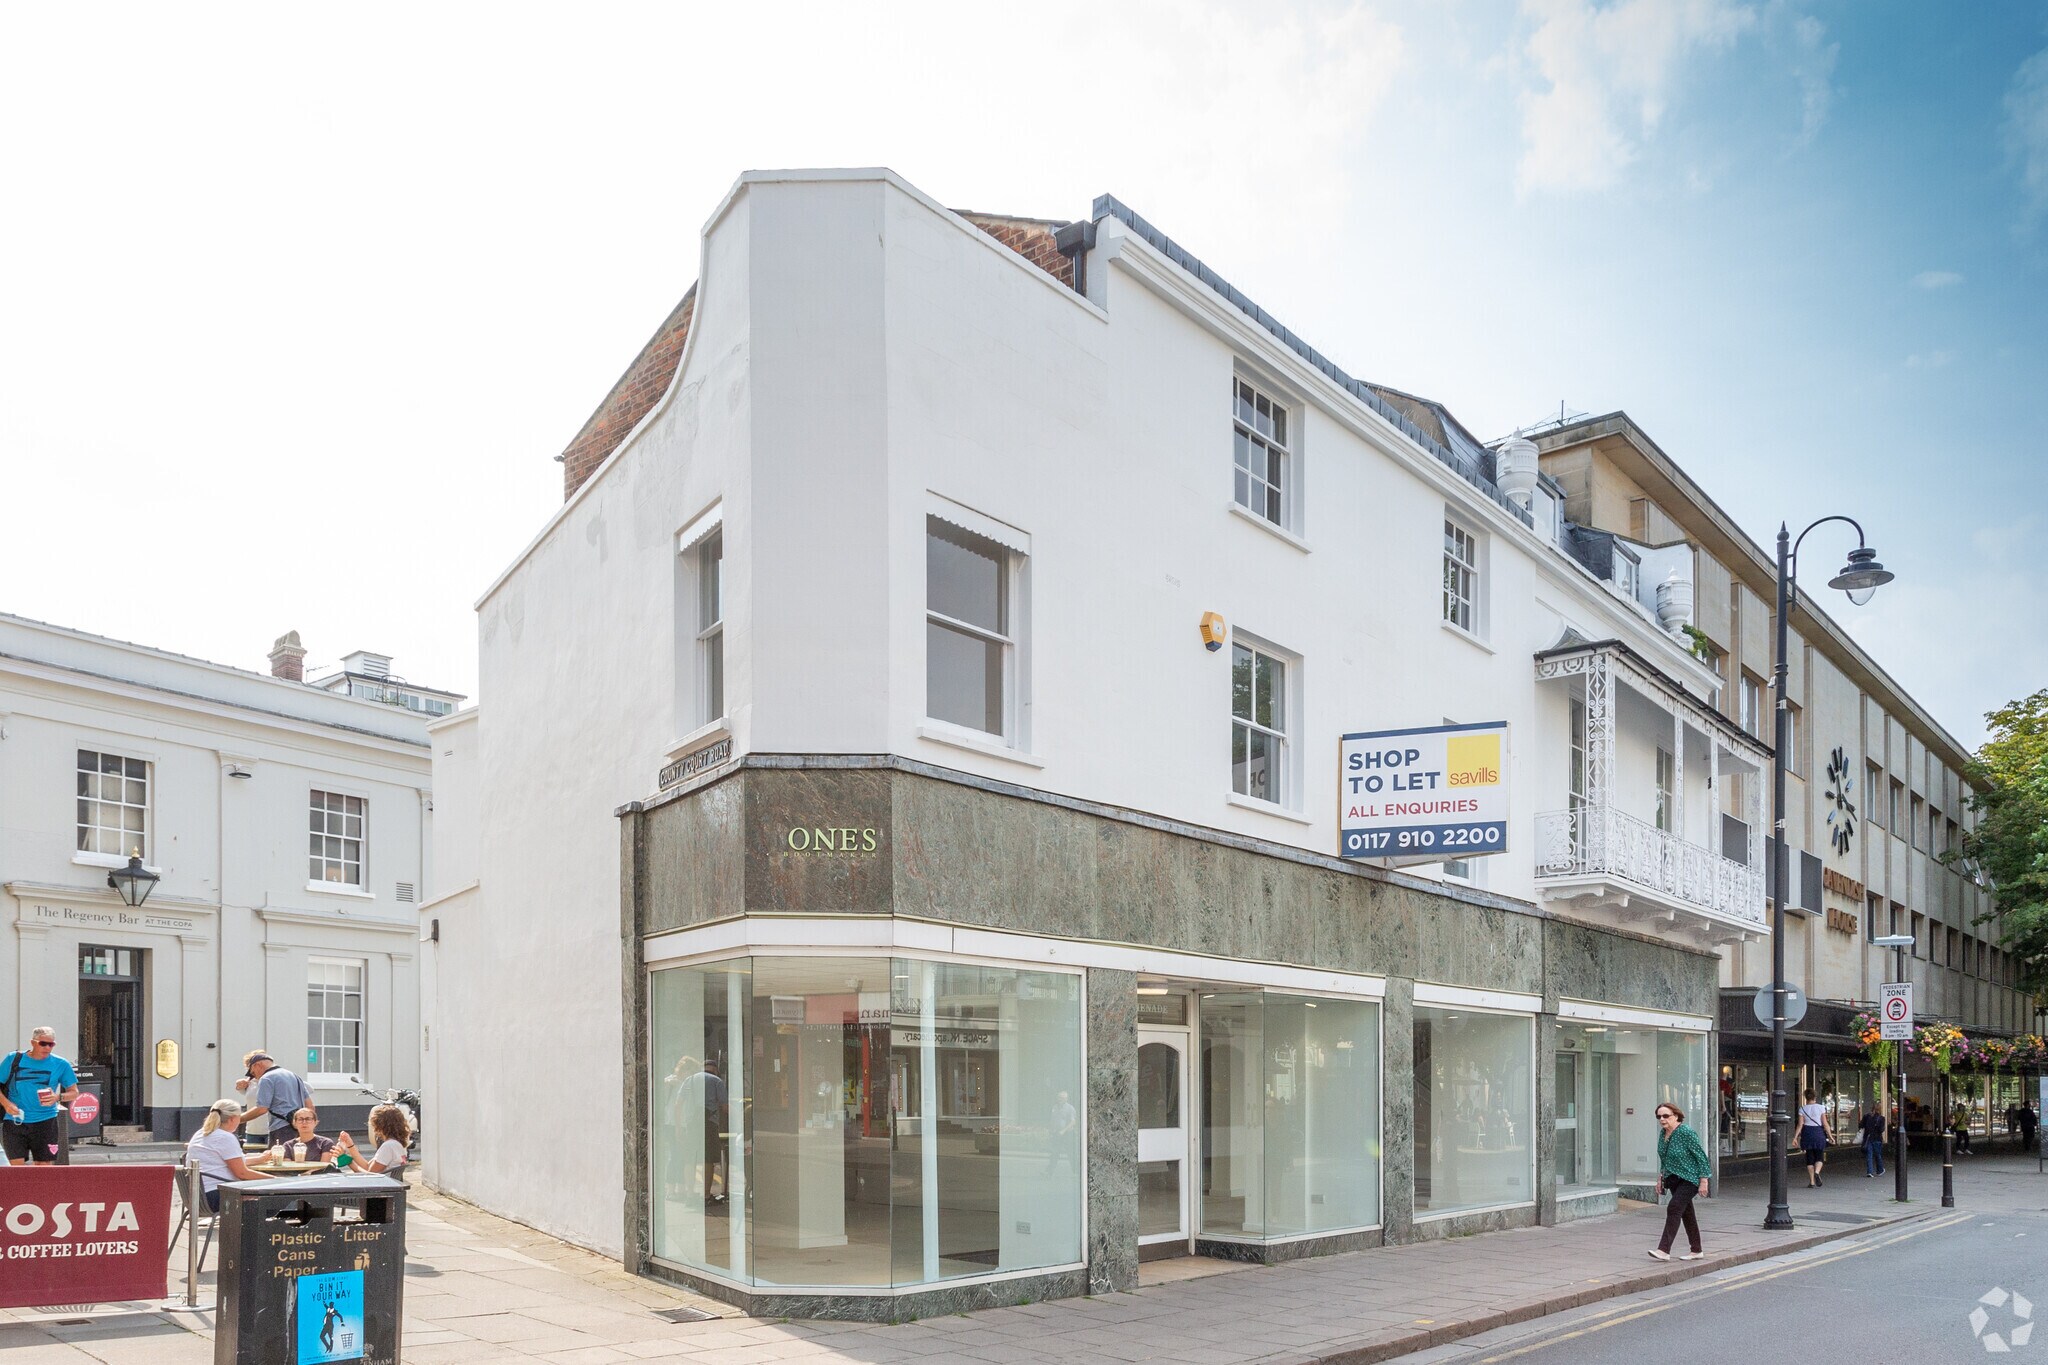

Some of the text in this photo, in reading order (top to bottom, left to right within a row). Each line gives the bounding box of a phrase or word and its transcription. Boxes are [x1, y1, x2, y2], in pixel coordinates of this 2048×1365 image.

[660, 742, 730, 785] COUNTY COURT ROAD
[1349, 749, 1420, 770] SHOP
[1349, 771, 1441, 794] TO LET
[1450, 767, 1498, 785] savills
[1348, 800, 1478, 818] ALL ENQUIRIES
[788, 827, 877, 852] ONES
[1348, 826, 1500, 850] 0117 910 2200
[34, 905, 59, 917] The
[63, 907, 115, 925] Regency
[118, 912, 140, 925] Bar
[157, 919, 171, 927] THE
[0, 1202, 140, 1238] OSTA
[271, 1233, 323, 1246] Plastic
[344, 1230, 381, 1242] Litter
[7, 1244, 72, 1259] COFFEE
[75, 1241, 139, 1257] LOVERS
[277, 1250, 316, 1261] Cans
[273, 1266, 318, 1279] Paper
[312, 1289, 351, 1301] YOUR WAY
[319, 1281, 344, 1292] BIN IT
